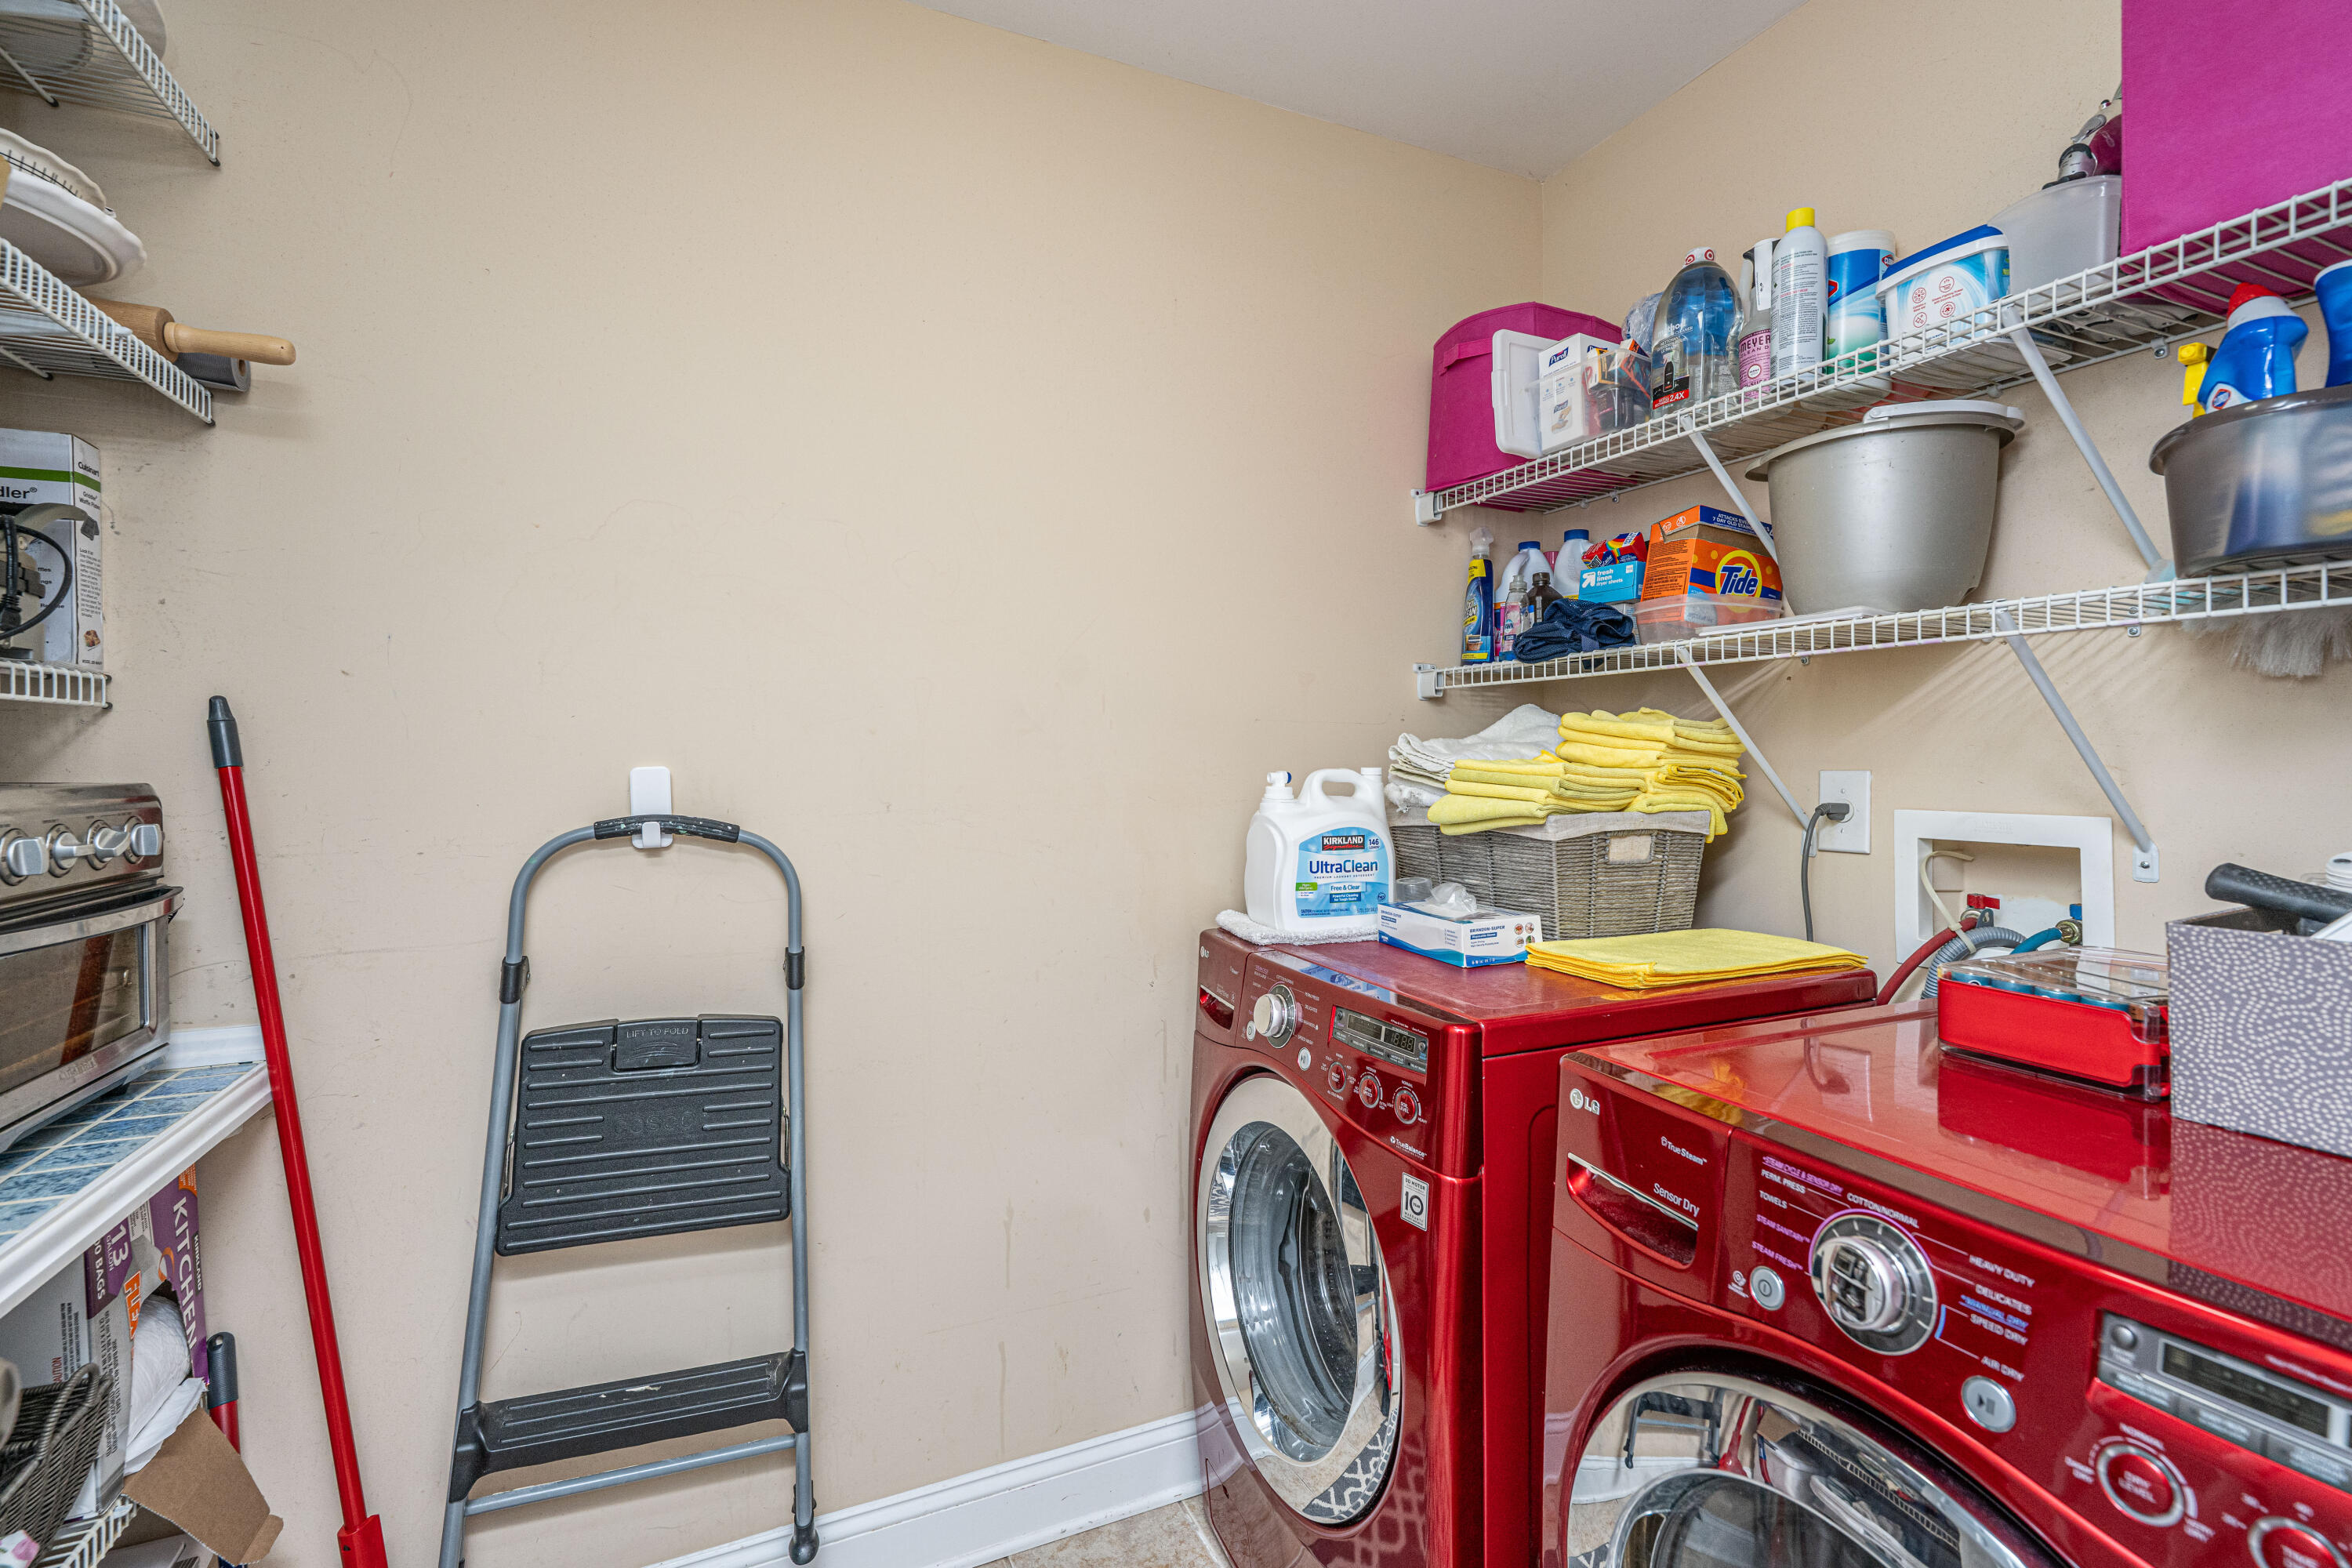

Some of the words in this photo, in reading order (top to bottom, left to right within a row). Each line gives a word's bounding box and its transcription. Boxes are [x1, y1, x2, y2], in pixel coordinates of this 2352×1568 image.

[1551, 349, 1568, 364] Purell
[1718, 513, 1738, 523] ATTACKS
[1737, 522, 1754, 531] STAIN
[1719, 564, 1759, 596] Tide
[1323, 836, 1363, 845] KIRKLAND
[1309, 859, 1378, 874] UltraClean
[626, 1029, 646, 1038] LIFT
[1584, 1096, 1600, 1116] LG
[1411, 1180, 1425, 1191] MOTOR
[1782, 1178, 1806, 1194] PRESS
[1404, 1191, 1424, 1216] 10
[1653, 1182, 1682, 1207] Sensor
[1682, 1197, 1700, 1218] Dry
[1759, 1189, 1788, 1210] TOWELS
[1846, 1192, 1919, 1229] COTTON/NORMAL
[106, 1234, 114, 1272] GALLON
[108, 1223, 129, 1267] 13
[1751, 1240, 1775, 1258] STEAM
[95, 1260, 106, 1301] BAGS
[172, 1196, 197, 1350] KITCHEN
[1969, 1254, 2004, 1276] HEAVY
[2003, 1268, 2035, 1288] DUTY
[1975, 1283, 2033, 1316] DELICATES
[1969, 1313, 2004, 1336] SPEED
[2004, 1328, 2029, 1346] DRY
[53, 1356, 62, 1383] AUTION
[1980, 1356, 2001, 1372] AIR
[2000, 1363, 2025, 1383] DRY
